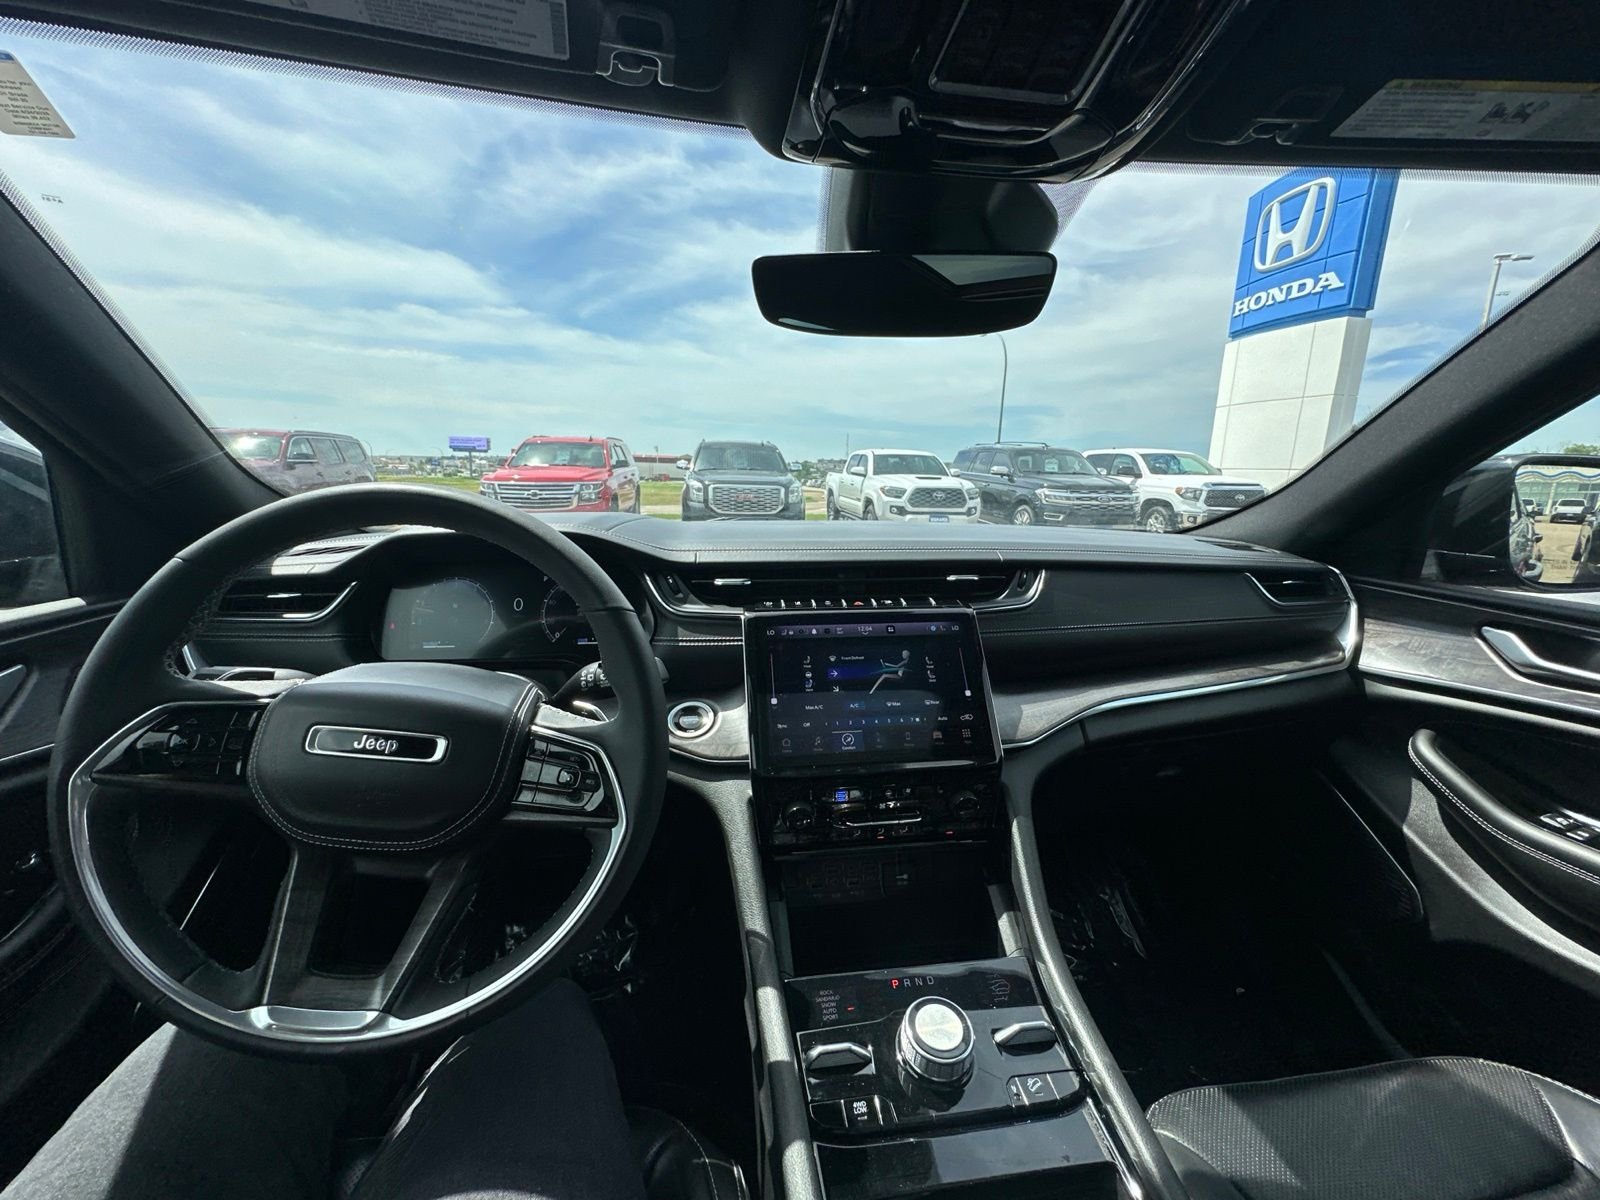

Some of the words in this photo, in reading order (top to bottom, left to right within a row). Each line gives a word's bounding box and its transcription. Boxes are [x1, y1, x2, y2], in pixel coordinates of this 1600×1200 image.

[1232, 271, 1345, 318] HONDA
[353, 734, 399, 754] Jeep
[891, 979, 899, 989] P
[903, 978, 911, 987] R
[914, 977, 923, 986] N
[926, 975, 934, 985] D
